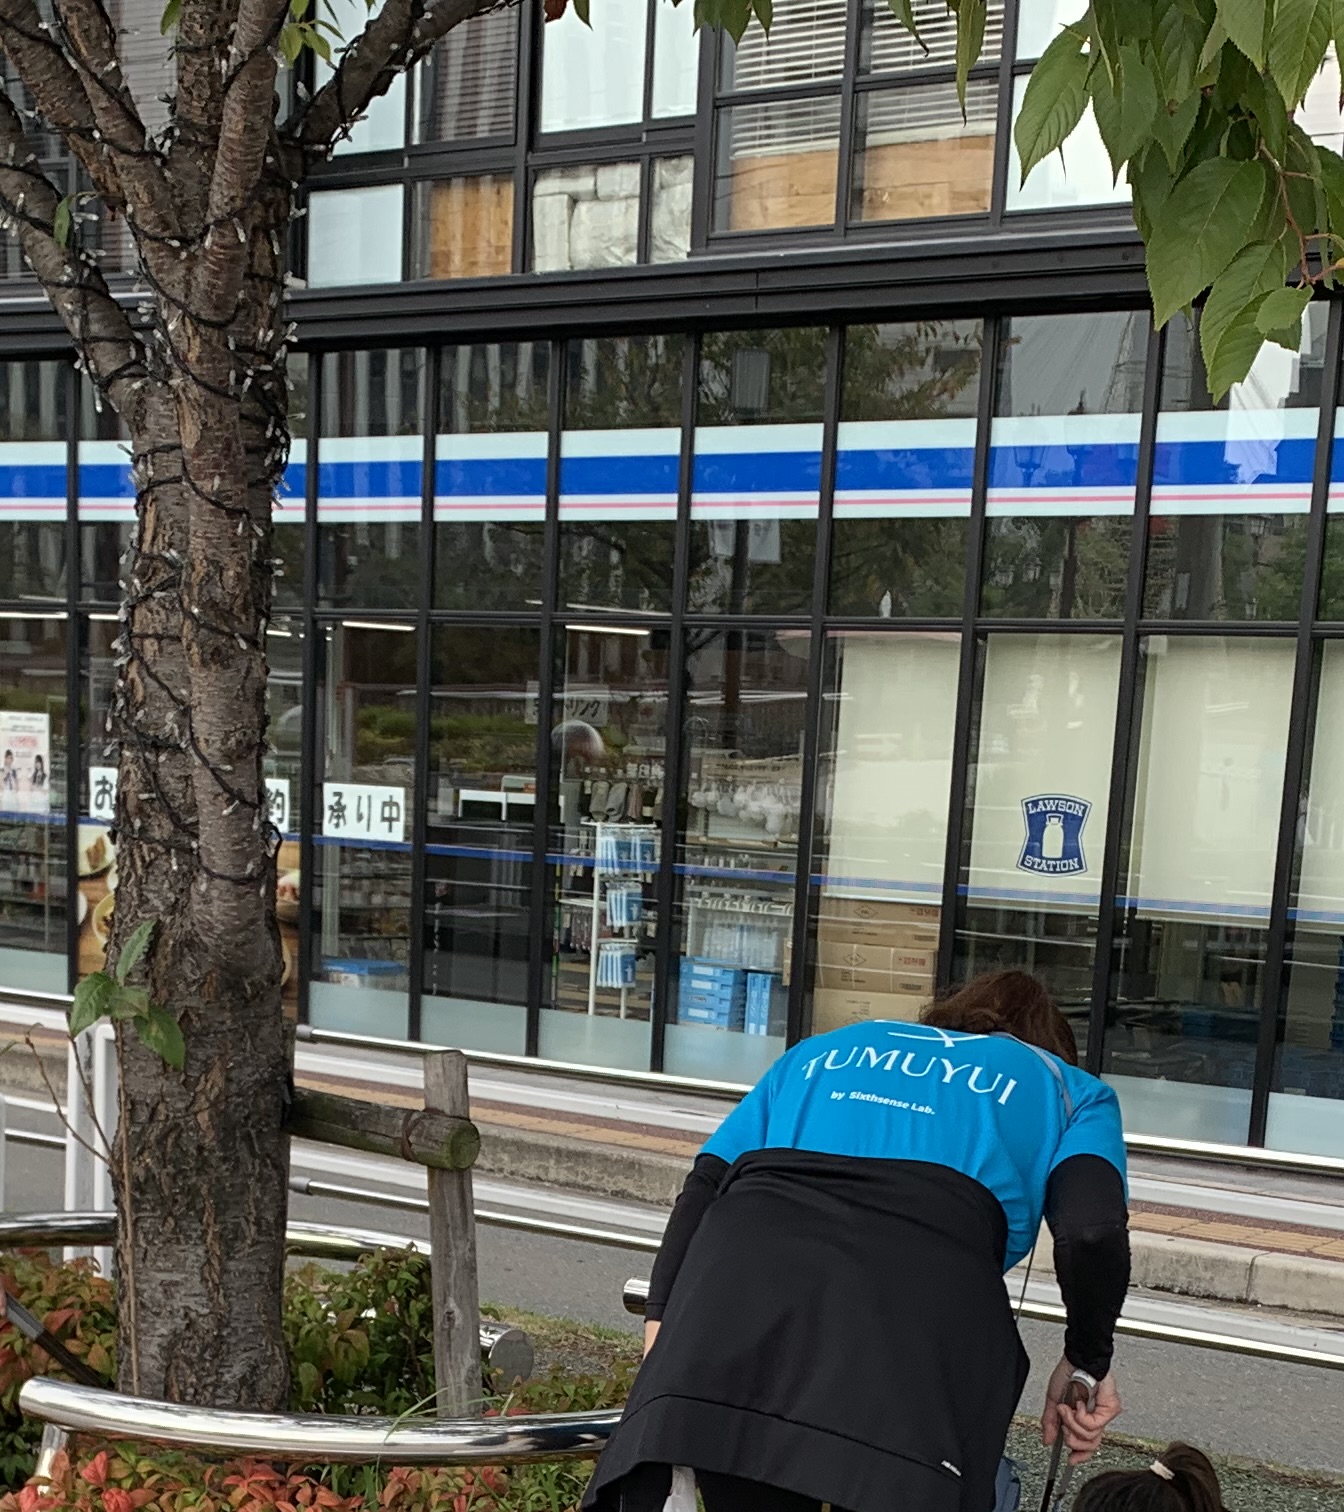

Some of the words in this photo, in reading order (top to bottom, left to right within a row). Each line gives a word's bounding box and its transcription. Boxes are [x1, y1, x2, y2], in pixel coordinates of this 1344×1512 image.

[326, 790, 402, 833] 承り中
[1027, 799, 1086, 818] LAWSON
[1023, 854, 1080, 872] STATION
[801, 1046, 1018, 1106] TUMUYUI
[829, 1090, 846, 1101] by
[848, 1090, 910, 1110] Sixthsense
[910, 1101, 936, 1116] Lab.
